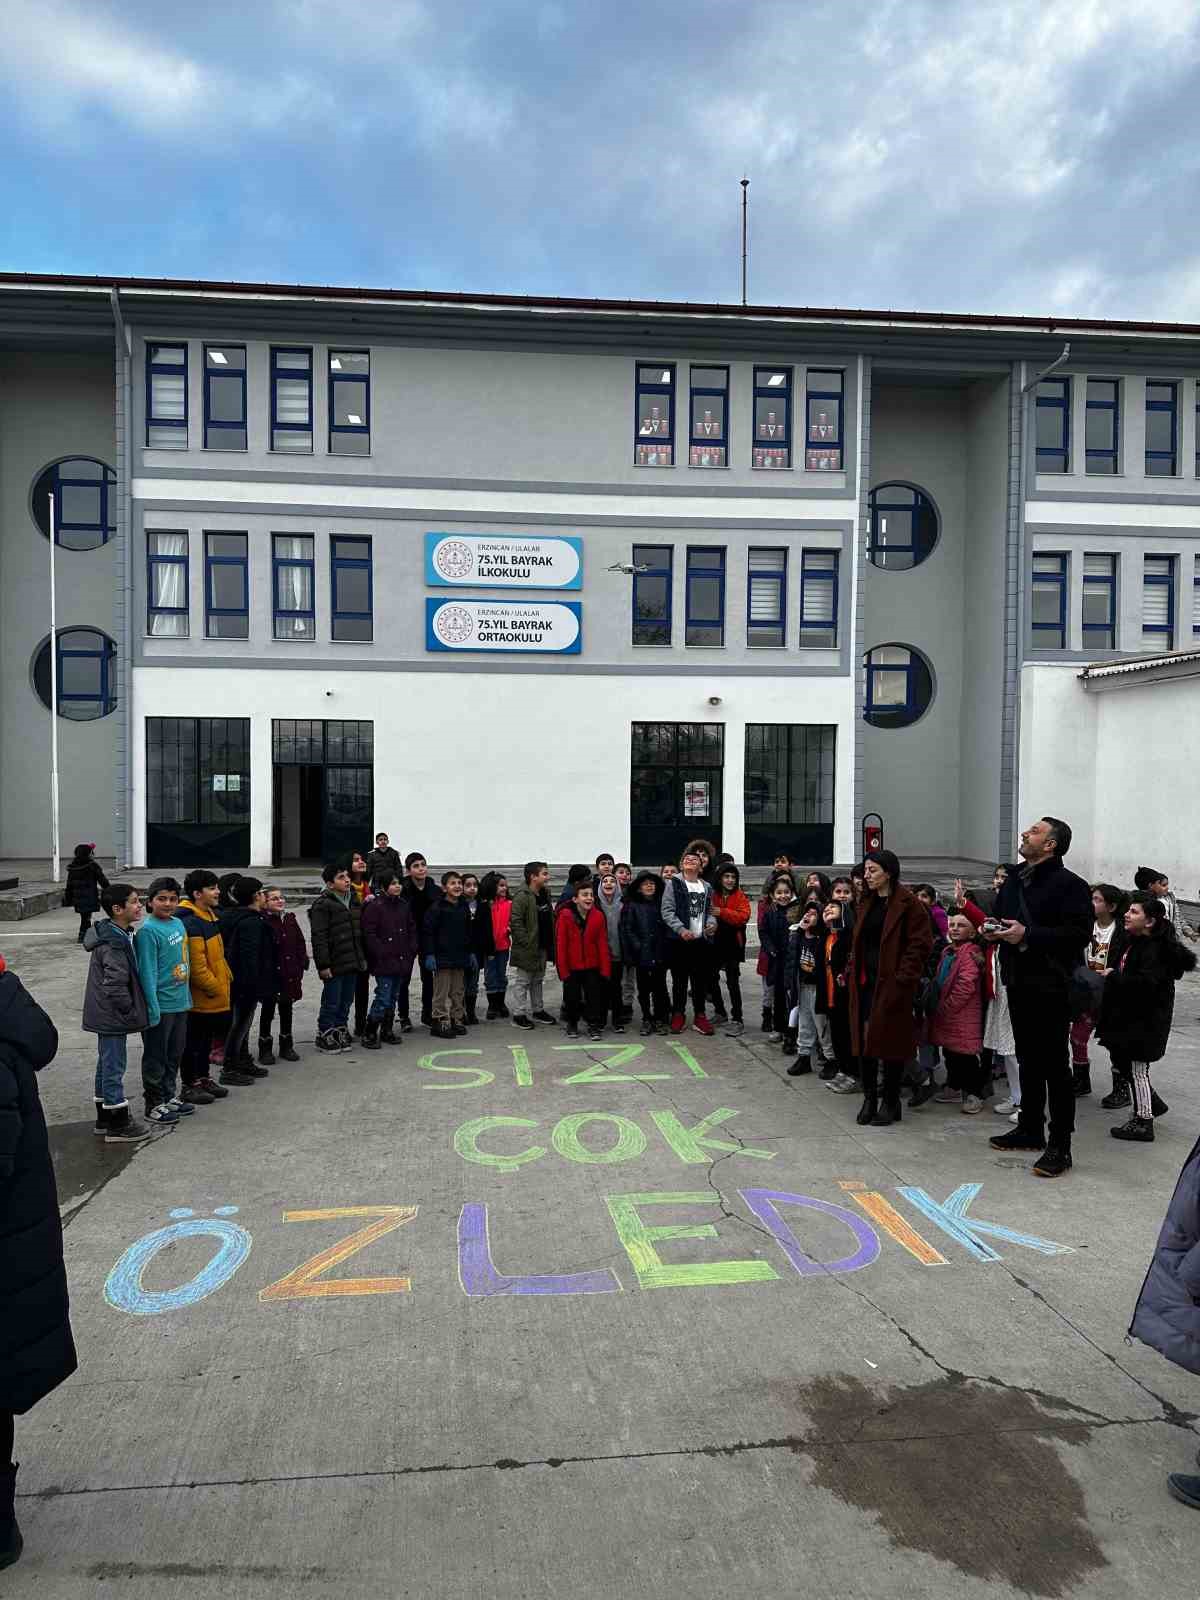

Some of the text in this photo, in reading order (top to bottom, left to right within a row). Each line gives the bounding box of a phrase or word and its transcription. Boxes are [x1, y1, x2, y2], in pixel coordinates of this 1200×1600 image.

[477, 554, 553, 567] 75.YIL BAYRAK
[477, 565, 531, 578] İLKOKULU
[477, 619, 553, 631] 75.YIL BAYRAK
[477, 632, 543, 643] ORTAOKULU
[453, 1107, 779, 1174] ÇOK
[102, 1181, 1078, 1316] ÖZLEDİK
